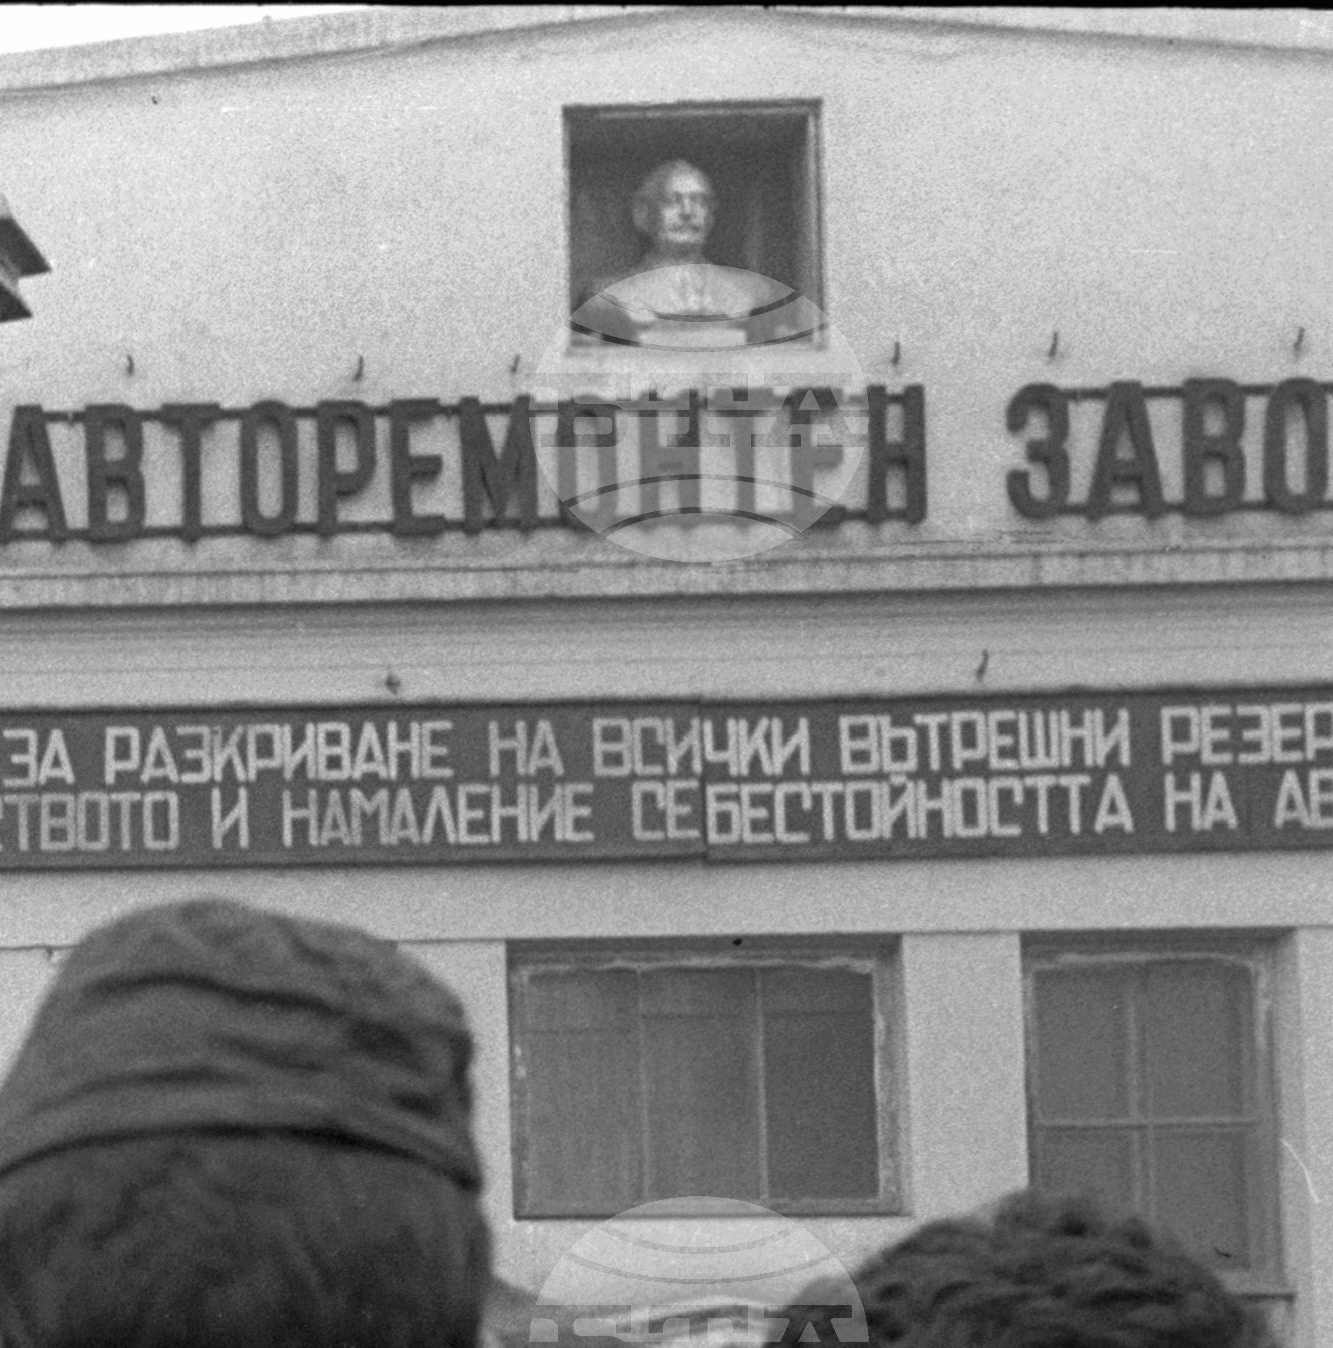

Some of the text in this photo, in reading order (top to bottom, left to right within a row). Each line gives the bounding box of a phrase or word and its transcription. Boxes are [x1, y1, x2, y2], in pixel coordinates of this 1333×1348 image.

[1006, 377, 1329, 521] ЗАВО
[3, 727, 75, 786] ЗА
[104, 719, 453, 784] РАЗКРИВАНЕ
[489, 719, 564, 776] НА
[592, 717, 810, 776] ВСИЧКИ
[839, 708, 1130, 774] ВЪТРЕШНИ
[1161, 702, 1333, 764] РЕЗЕР
[211, 786, 249, 848] И
[283, 782, 594, 847] НАМАЛЕНИЕ
[631, 774, 1133, 844] СЕБЕСТОЙНОСТТА
[1165, 771, 1237, 831] НА
